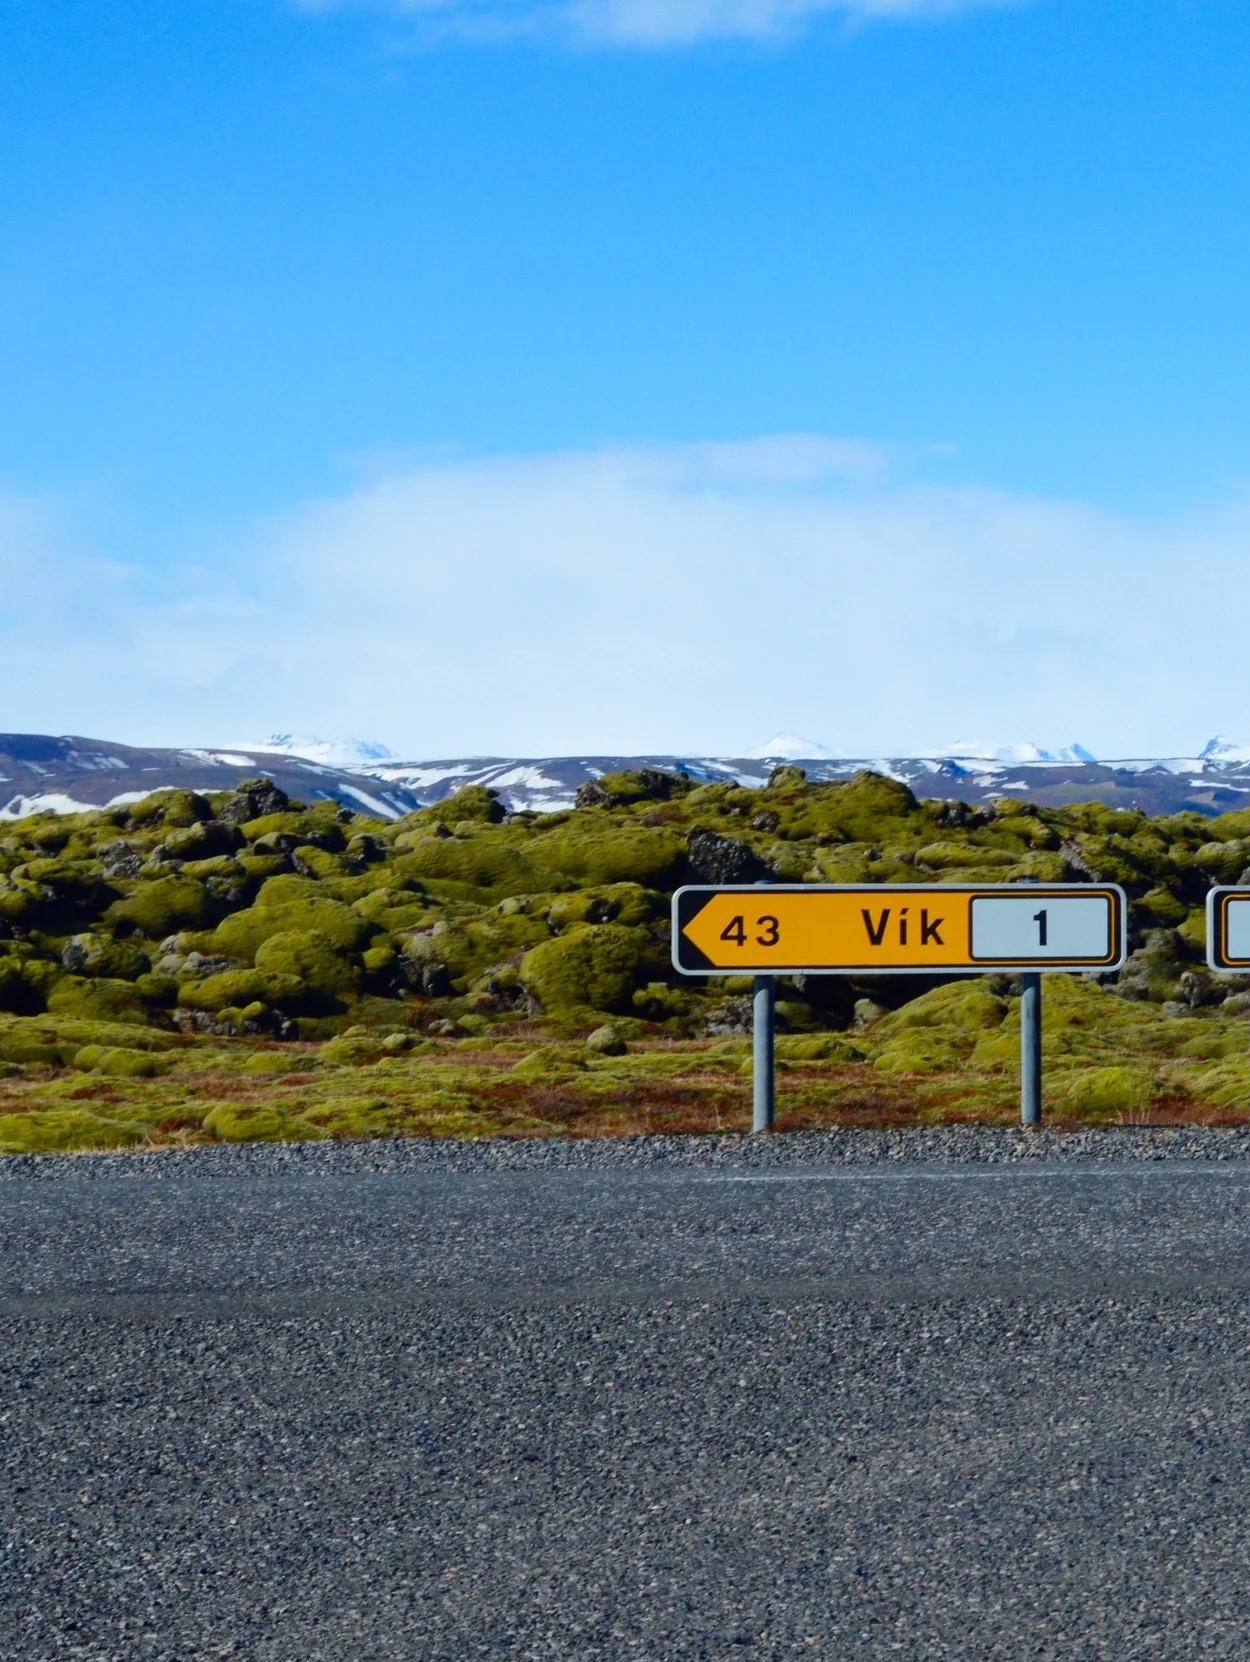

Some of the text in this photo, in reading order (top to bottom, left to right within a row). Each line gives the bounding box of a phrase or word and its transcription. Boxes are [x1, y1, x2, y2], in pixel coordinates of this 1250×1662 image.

[720, 908, 1047, 946] 43 Vík 1
